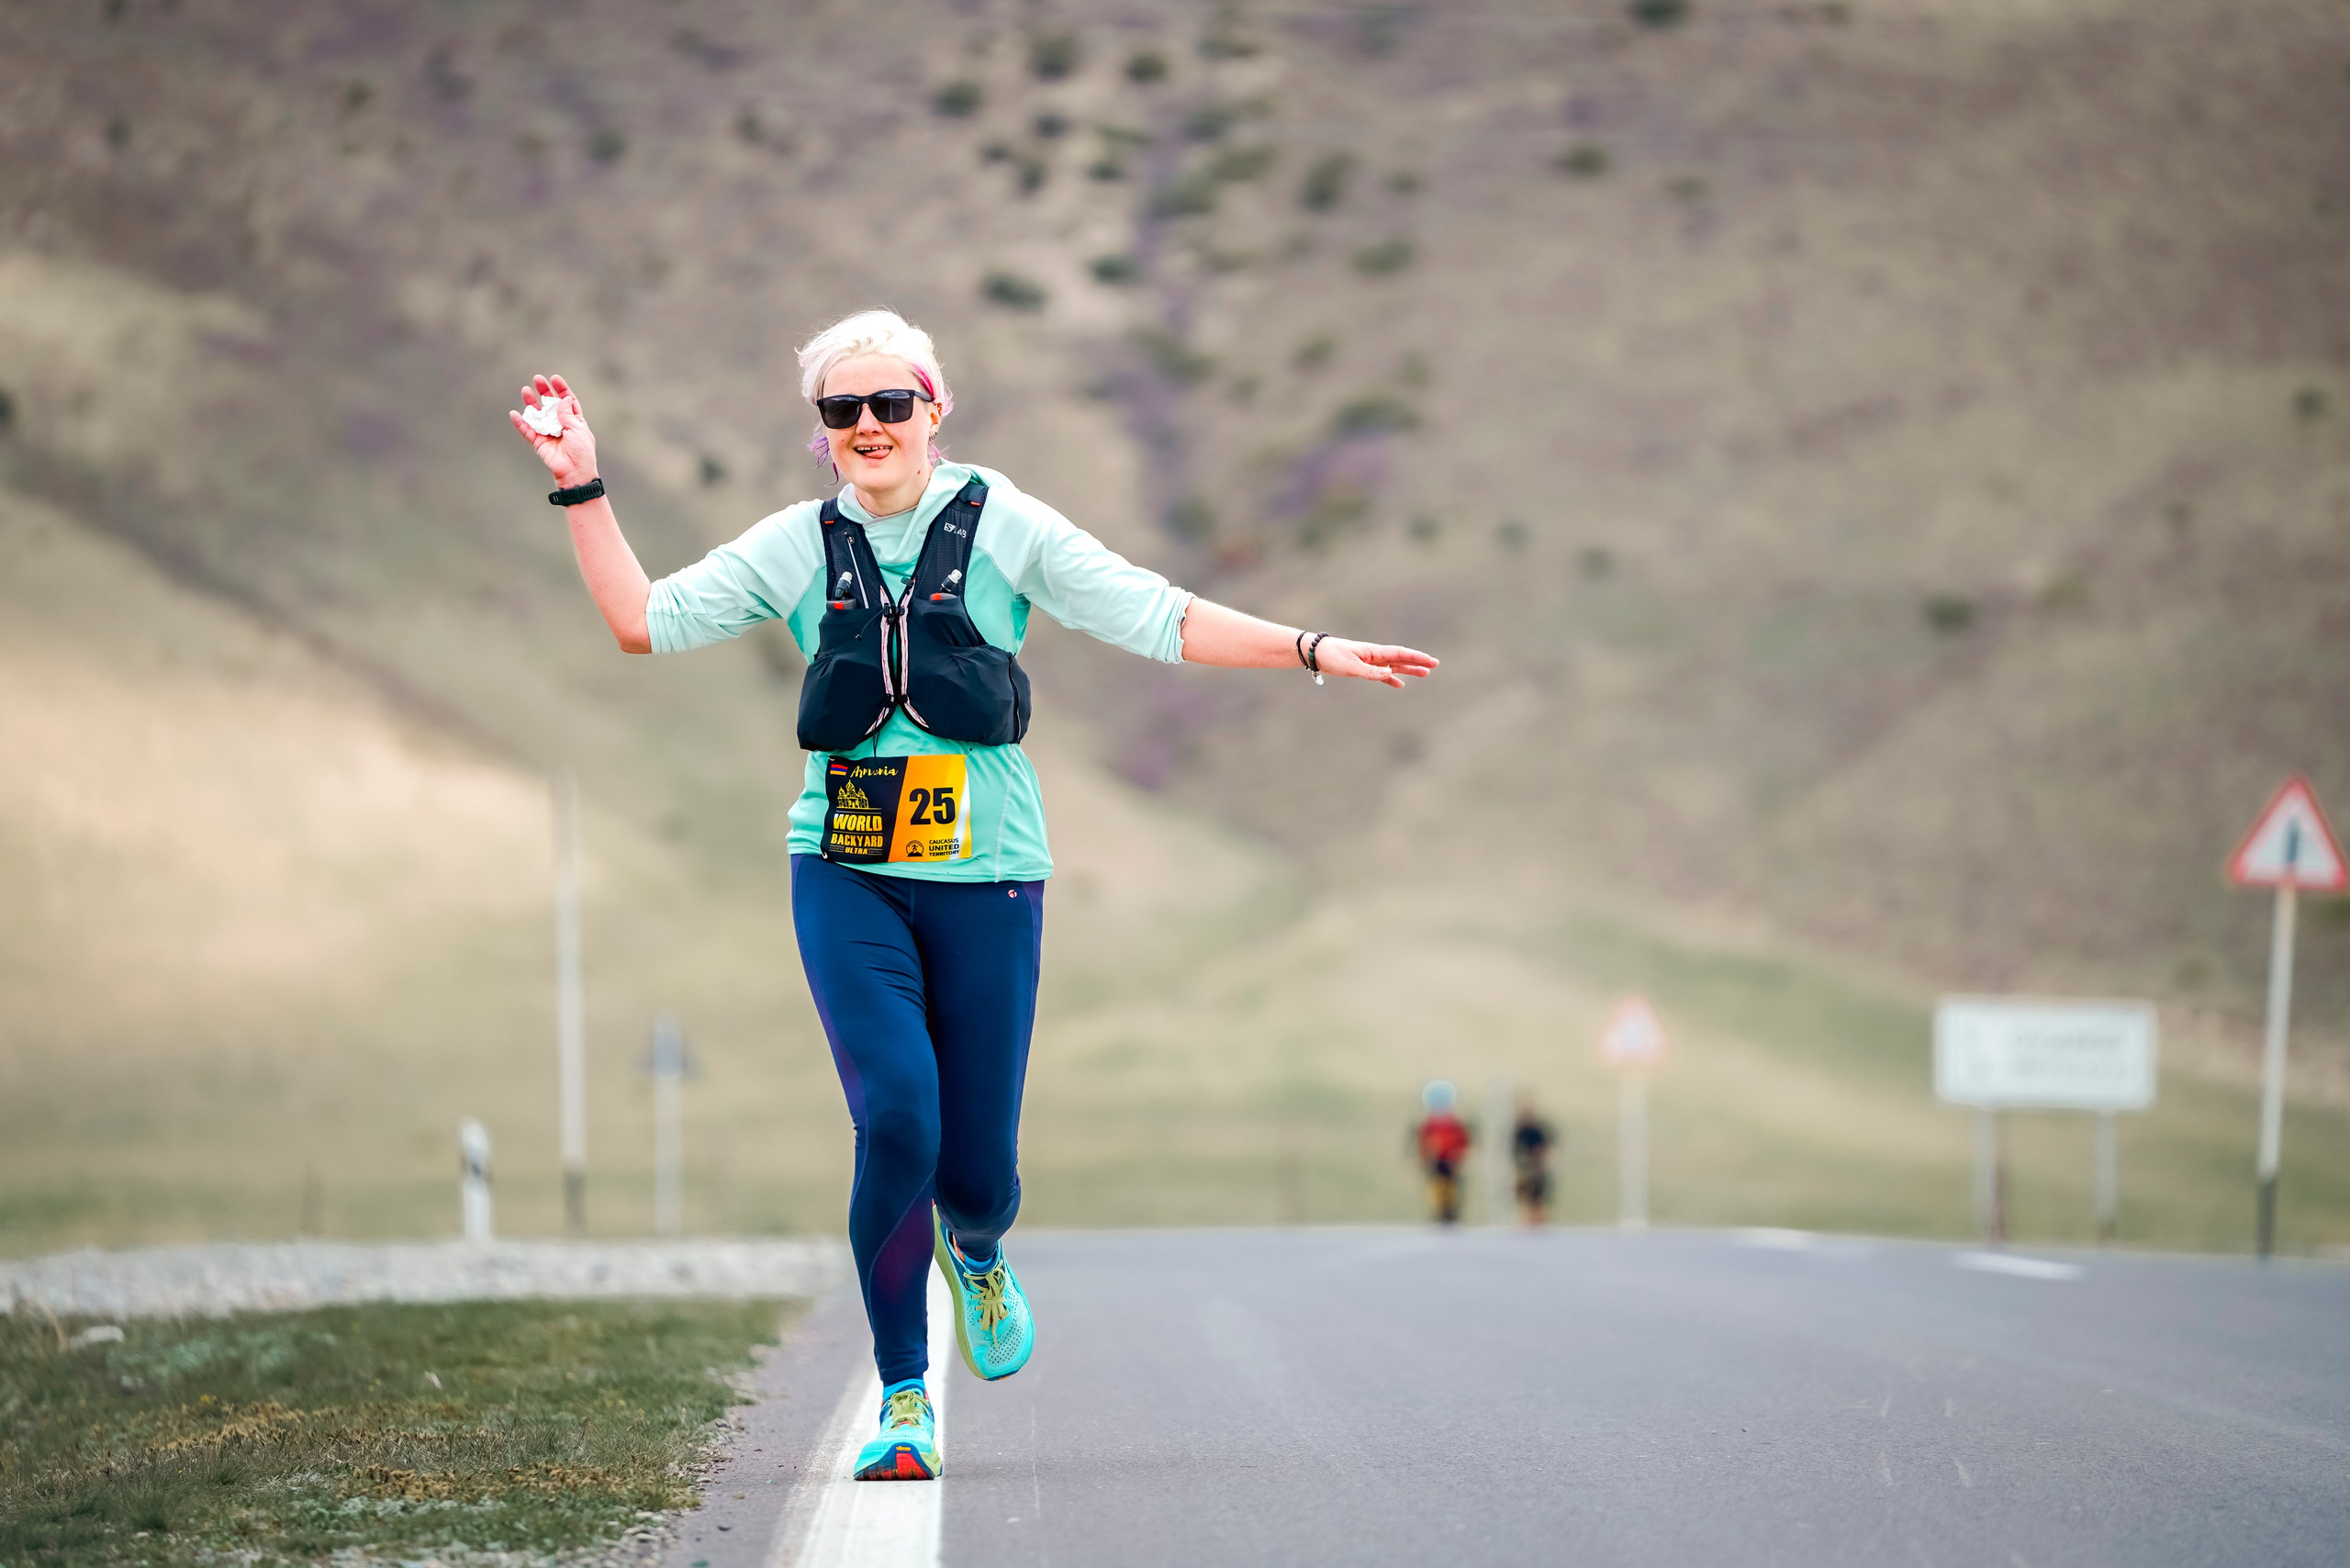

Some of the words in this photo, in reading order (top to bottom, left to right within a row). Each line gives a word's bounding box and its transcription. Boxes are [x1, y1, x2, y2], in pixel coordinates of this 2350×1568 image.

[850, 766, 898, 778] Armenia
[909, 787, 956, 825] 25
[834, 813, 883, 832] WORLD
[831, 833, 883, 847] BACKYARD
